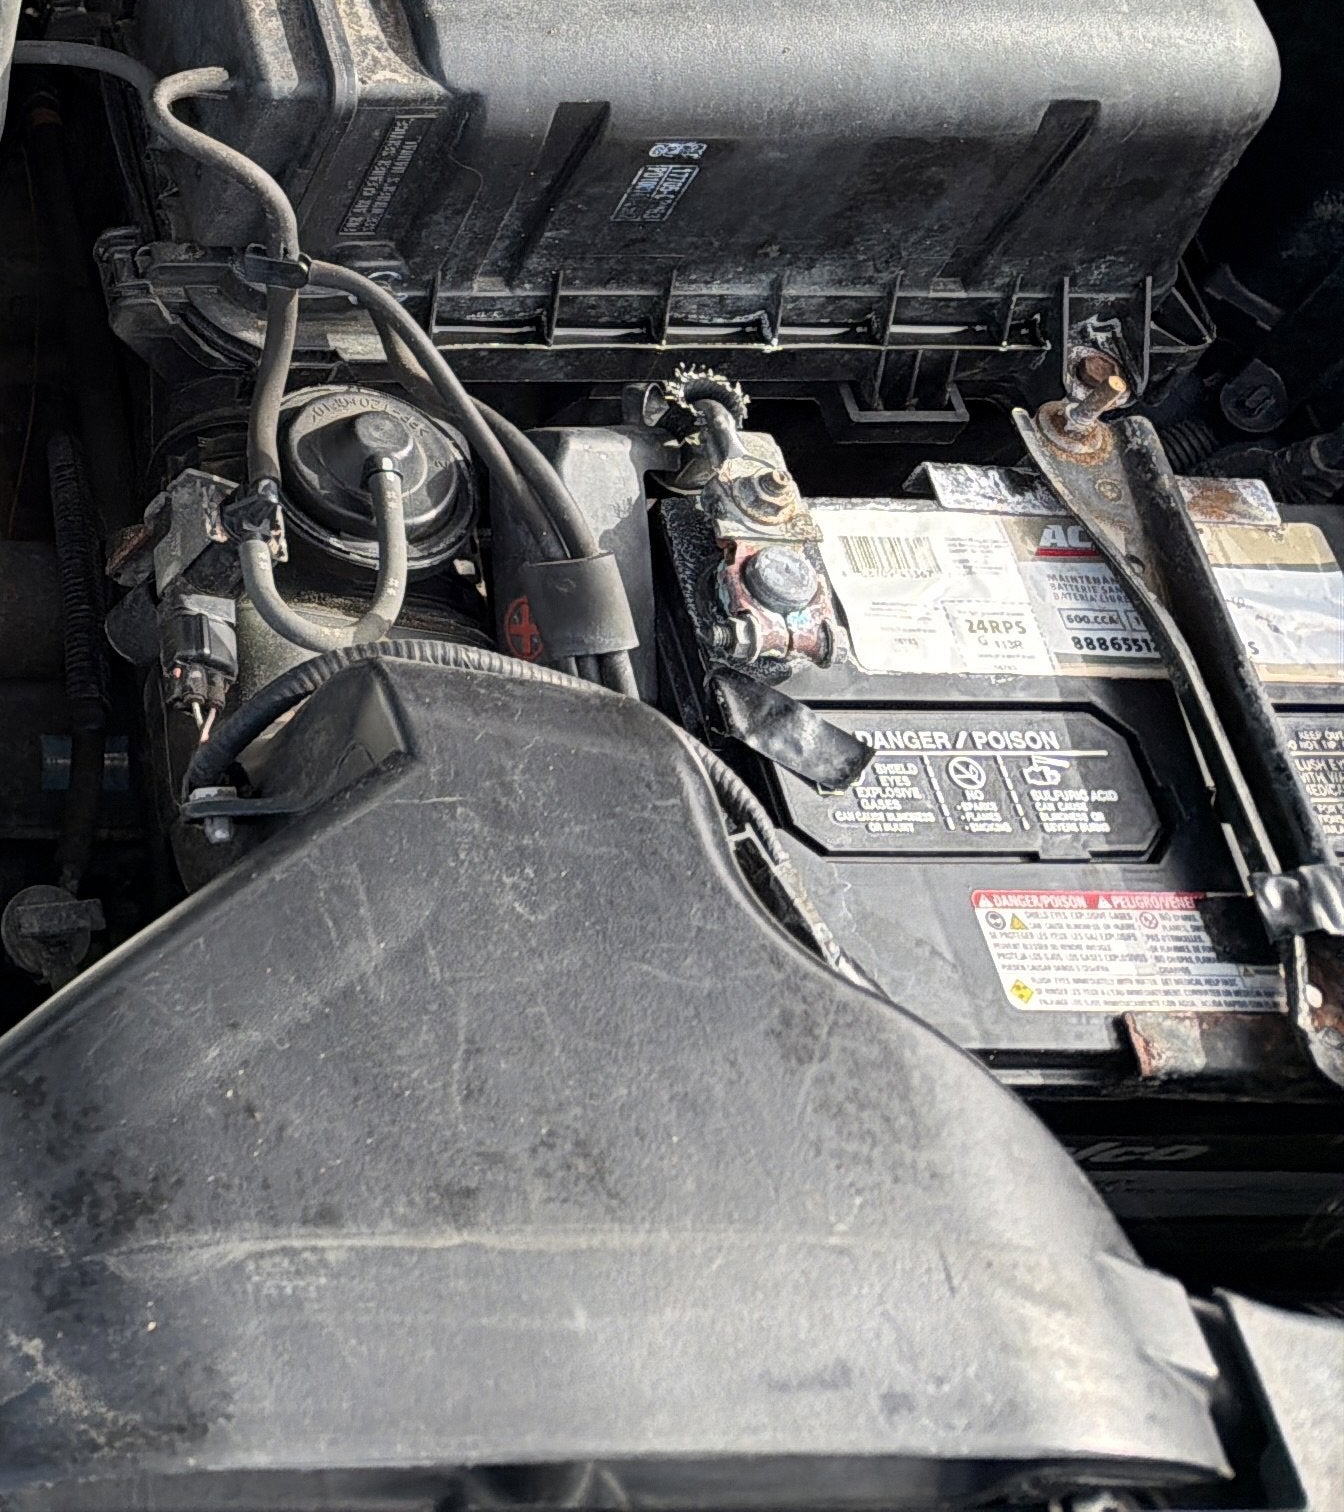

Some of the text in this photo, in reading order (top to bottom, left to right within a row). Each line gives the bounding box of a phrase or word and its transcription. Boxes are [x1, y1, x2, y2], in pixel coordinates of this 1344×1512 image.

[965, 619, 1027, 635] 24RPS
[970, 731, 1060, 749] POISON
[874, 763, 918, 775] SHIELD
[1294, 758, 1327, 771] LUSH
[880, 775, 910, 787] EYES
[856, 787, 921, 799] EXPLOSIVE
[965, 790, 985, 801] NO
[1090, 790, 1118, 801] ACID
[993, 895, 1087, 909] DANGER/POISON
